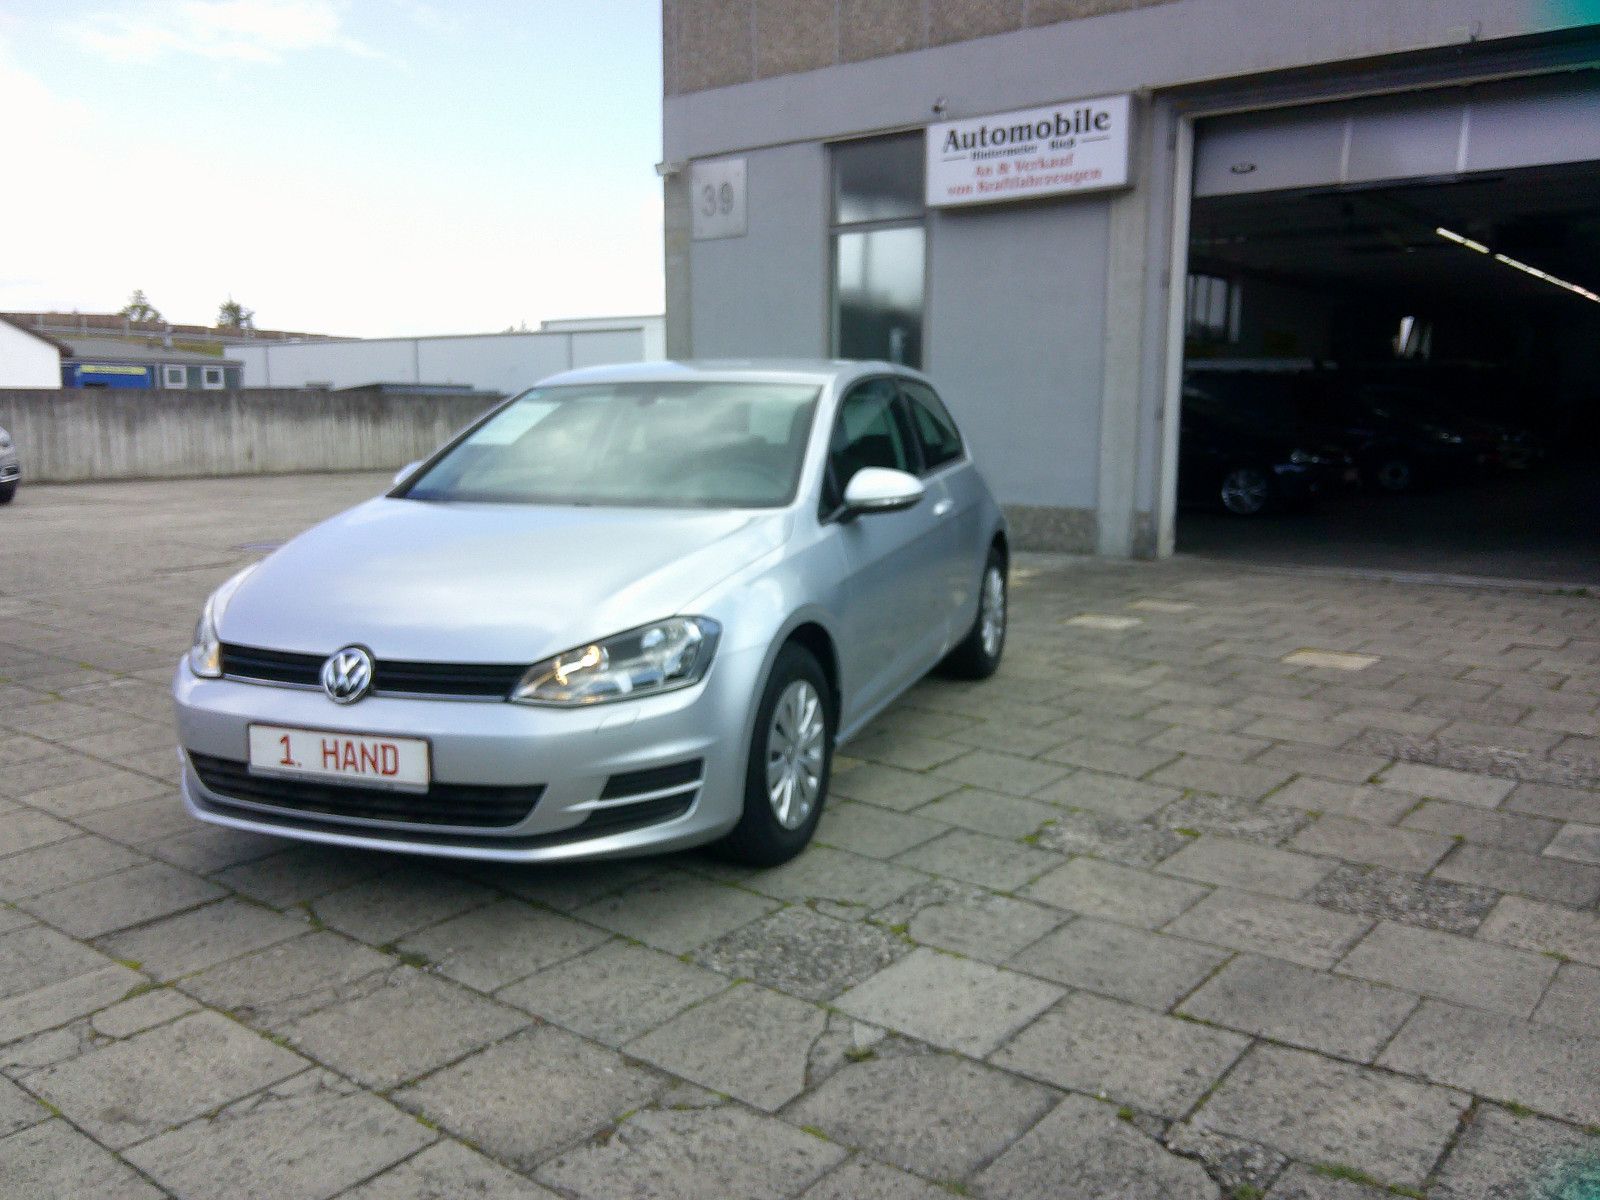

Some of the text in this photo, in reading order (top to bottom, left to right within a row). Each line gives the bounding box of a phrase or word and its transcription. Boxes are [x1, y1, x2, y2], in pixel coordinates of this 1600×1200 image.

[943, 108, 1111, 153] Automobile
[1014, 153, 1074, 172] Verkauf
[702, 181, 734, 217] 39
[279, 734, 400, 777] 1. HAND
